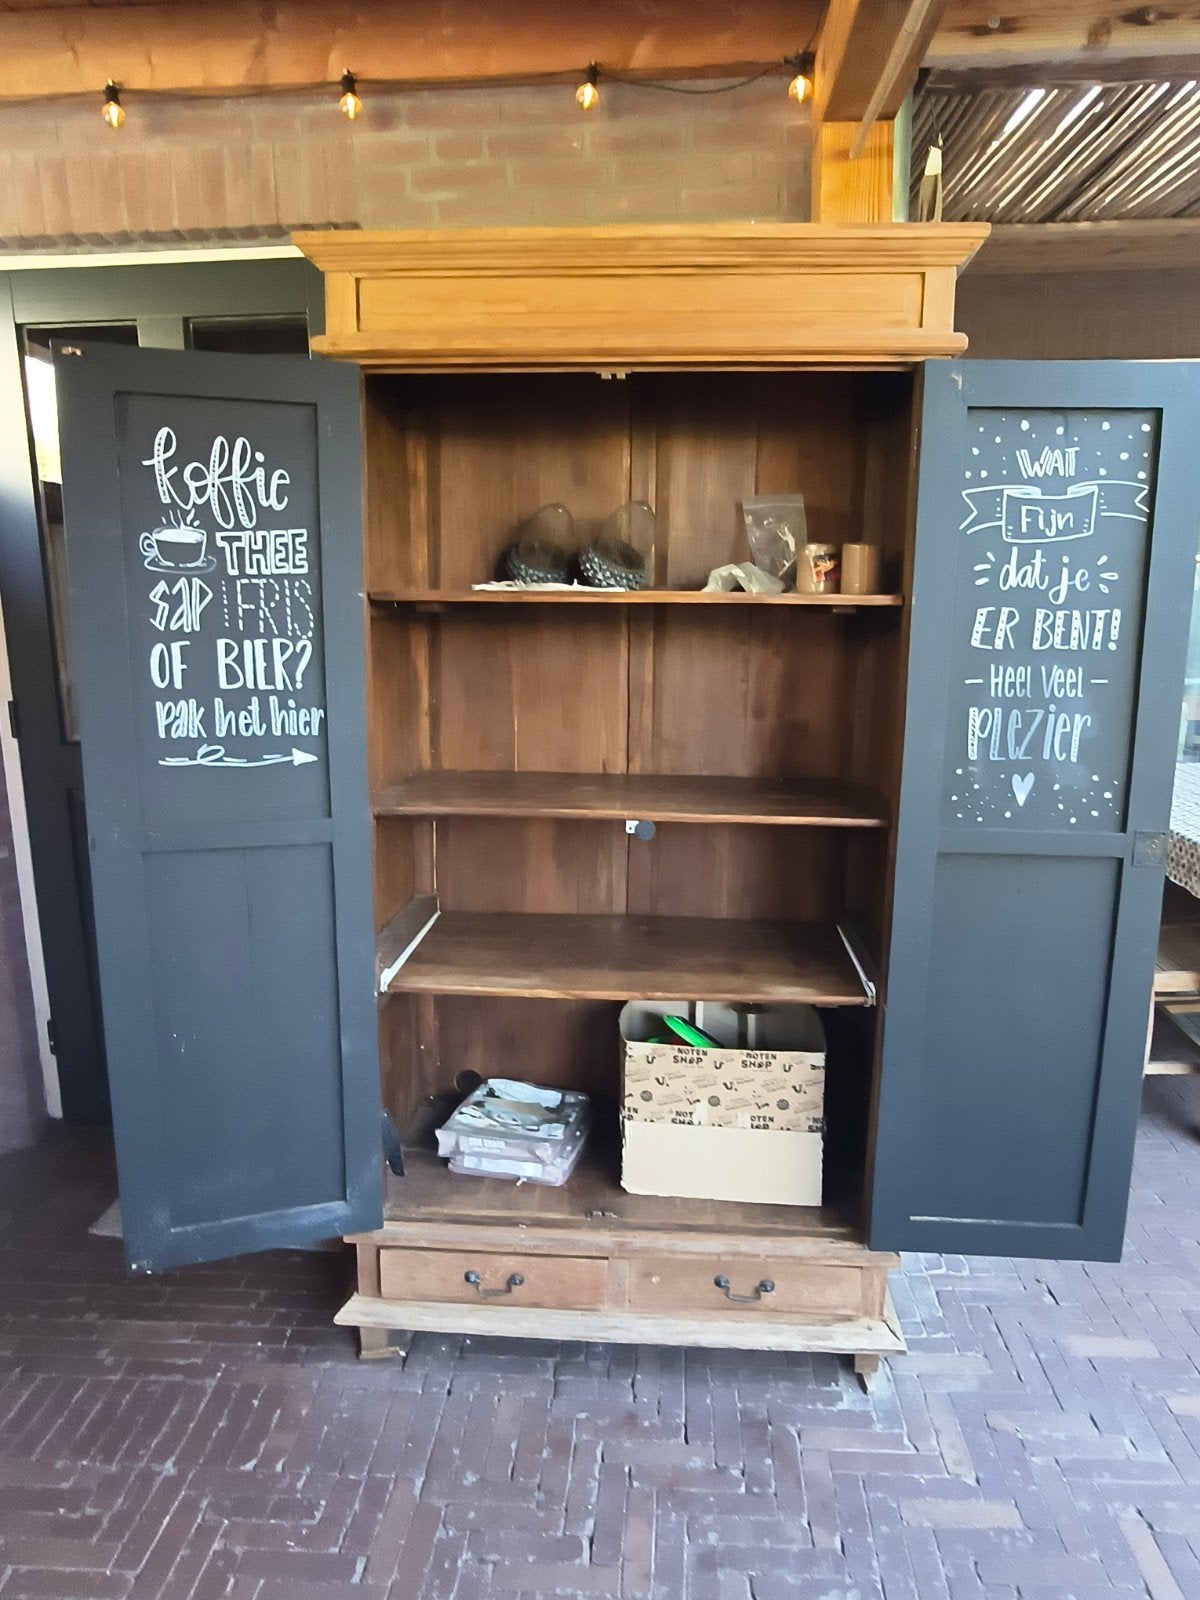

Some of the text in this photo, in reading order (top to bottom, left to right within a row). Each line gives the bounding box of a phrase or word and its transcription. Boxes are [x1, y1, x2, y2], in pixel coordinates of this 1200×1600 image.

[142, 426, 291, 529] koffie
[1016, 446, 1080, 477] WAT
[1020, 505, 1074, 537] Fijn
[215, 528, 309, 576] THEE
[999, 546, 1091, 605] dat je
[149, 577, 213, 633] SAP
[970, 606, 1122, 651] ER BENT!
[150, 638, 313, 692] OF BIER?
[990, 664, 1032, 698] Heel
[214, 696, 267, 738] het
[269, 695, 325, 737] hier
[677, 1047, 708, 1056] NOTEN
[745, 1052, 777, 1060] NOTEN
